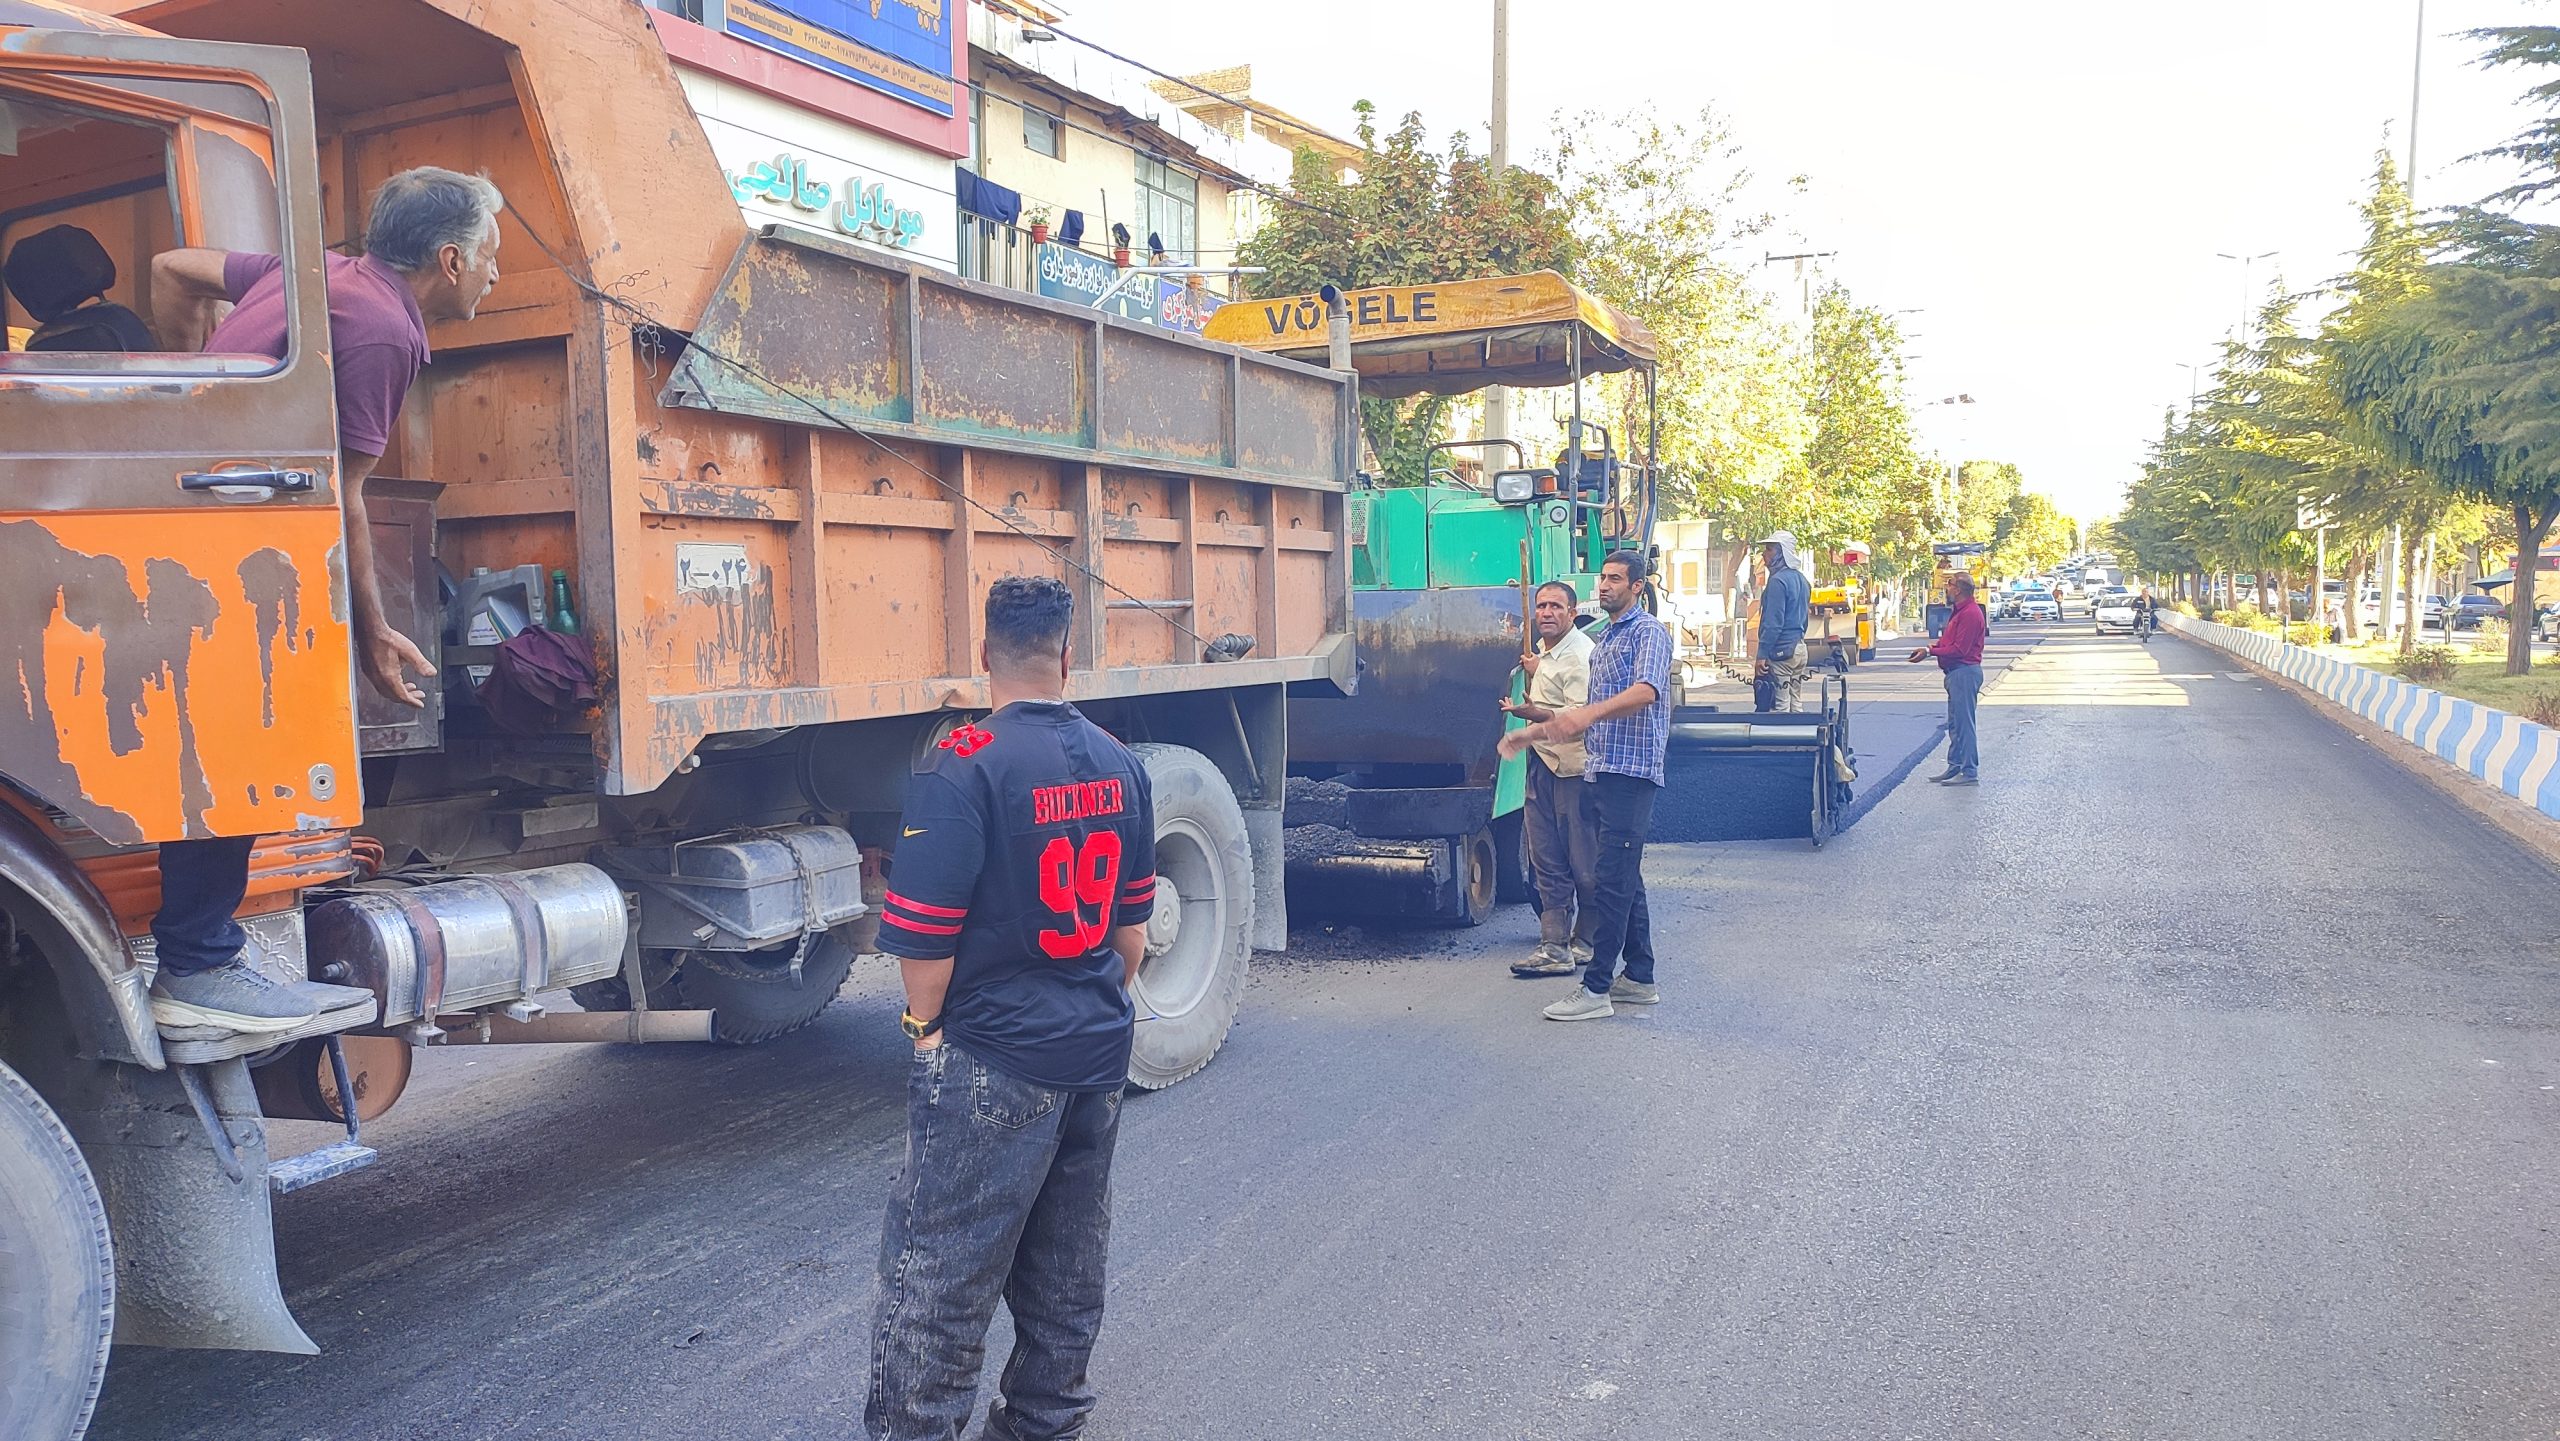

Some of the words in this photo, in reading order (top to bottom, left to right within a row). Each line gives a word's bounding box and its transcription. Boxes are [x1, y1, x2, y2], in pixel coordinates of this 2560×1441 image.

[724, 152, 832, 211] صالحی
[835, 176, 925, 248] موبایل
[1032, 778, 1125, 825] BUCKNER
[1038, 830, 1122, 960] 99
